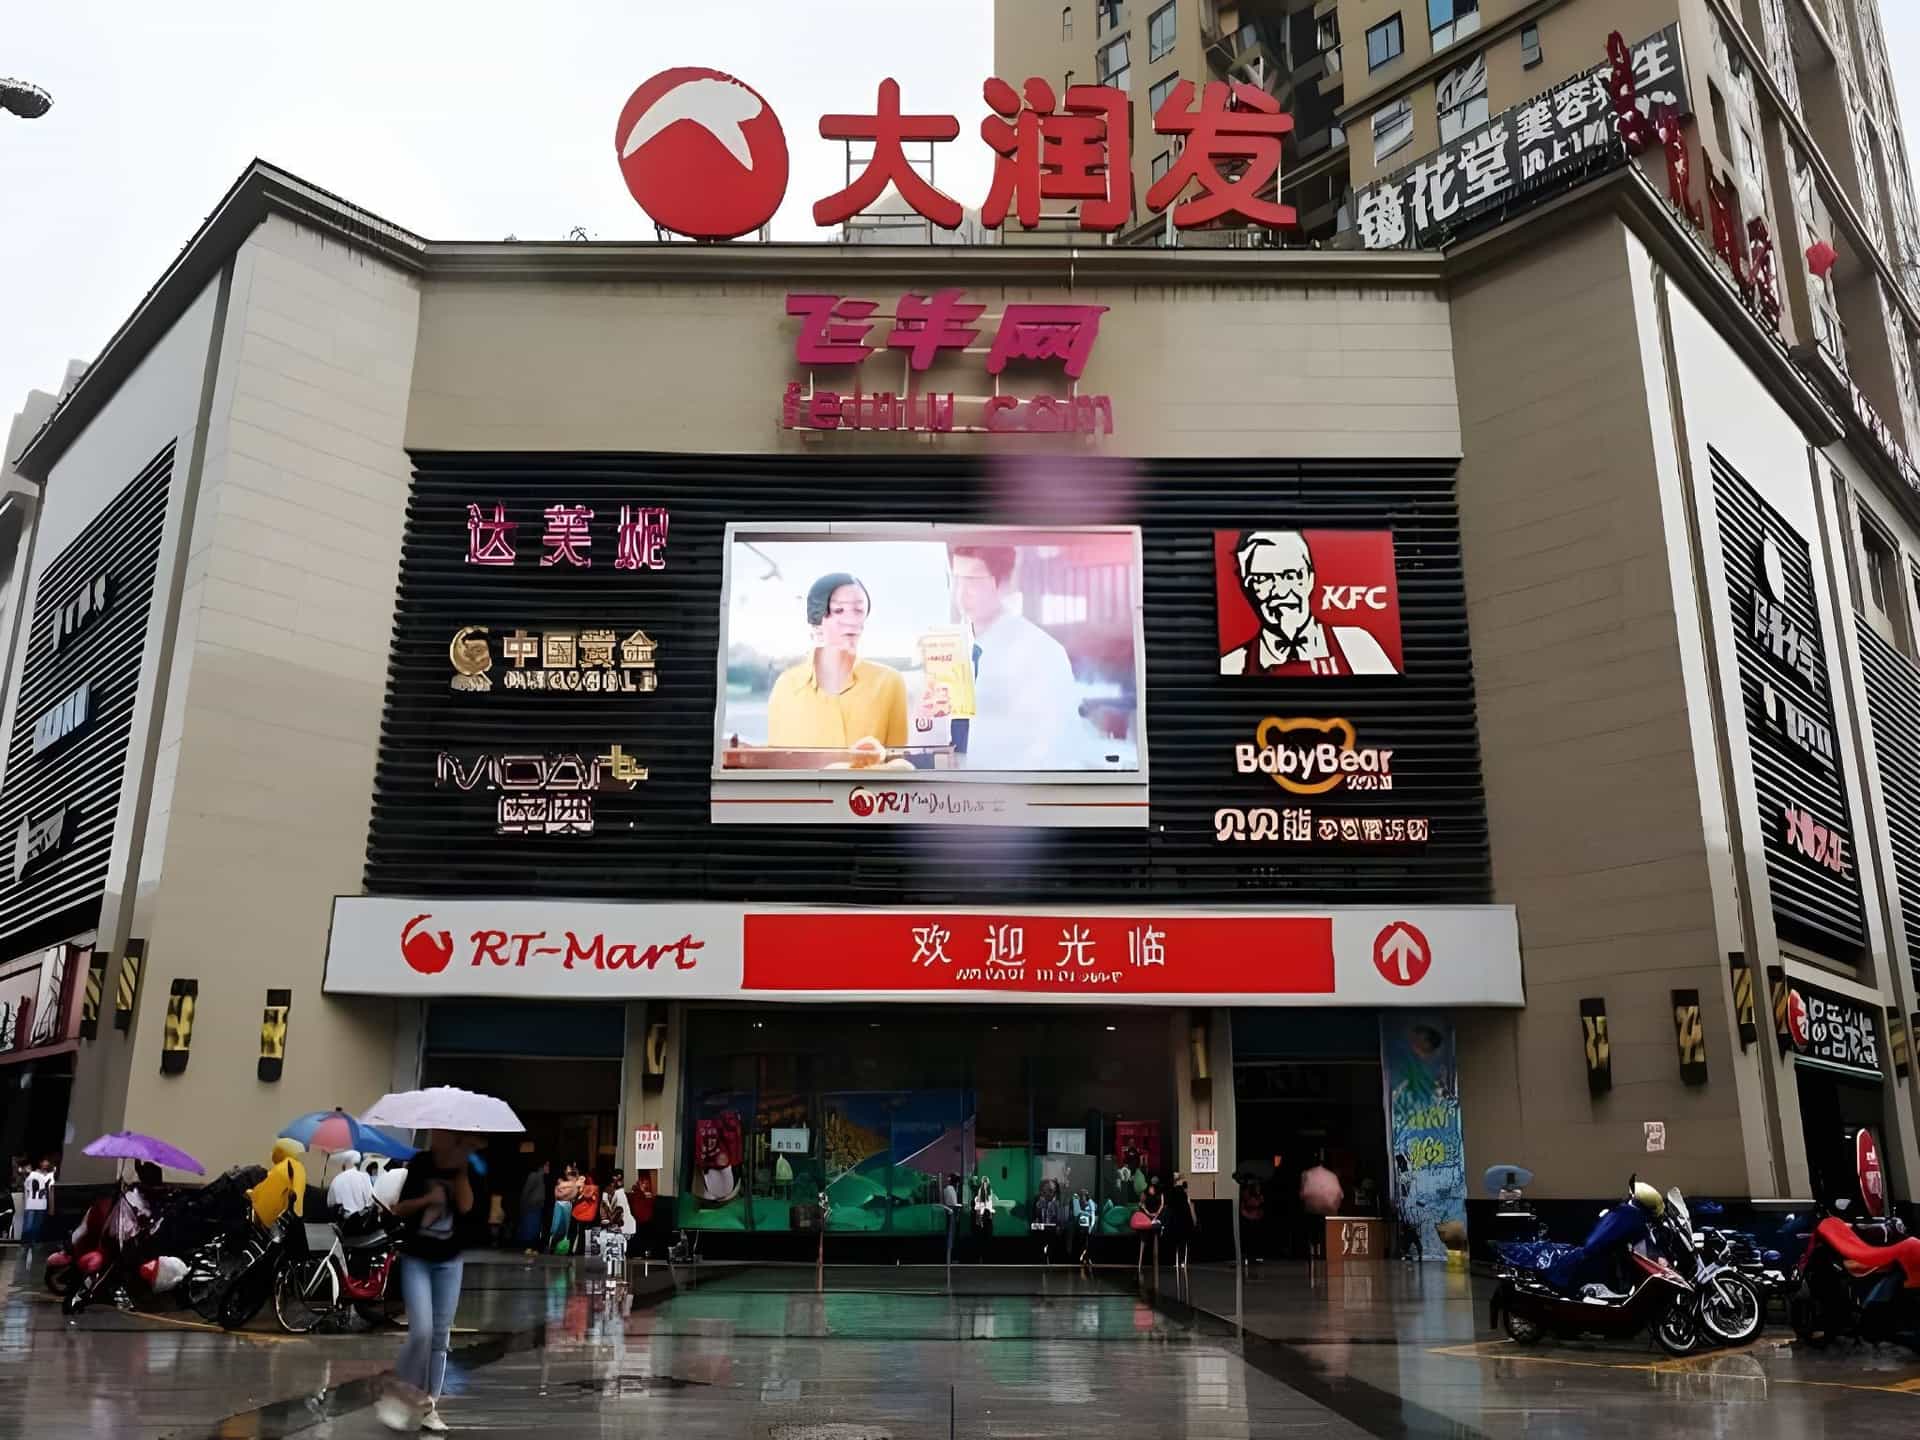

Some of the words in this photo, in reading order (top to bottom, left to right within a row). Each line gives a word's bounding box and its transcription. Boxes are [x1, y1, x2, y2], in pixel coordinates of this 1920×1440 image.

[813, 77, 1298, 232] 大润发
[786, 288, 1111, 379] 飞牛网
[1321, 585, 1388, 610] KFC
[1235, 744, 1393, 780] BabyBear
[470, 930, 704, 970] RT-Mart
[911, 923, 1166, 968] 欢迎光临
